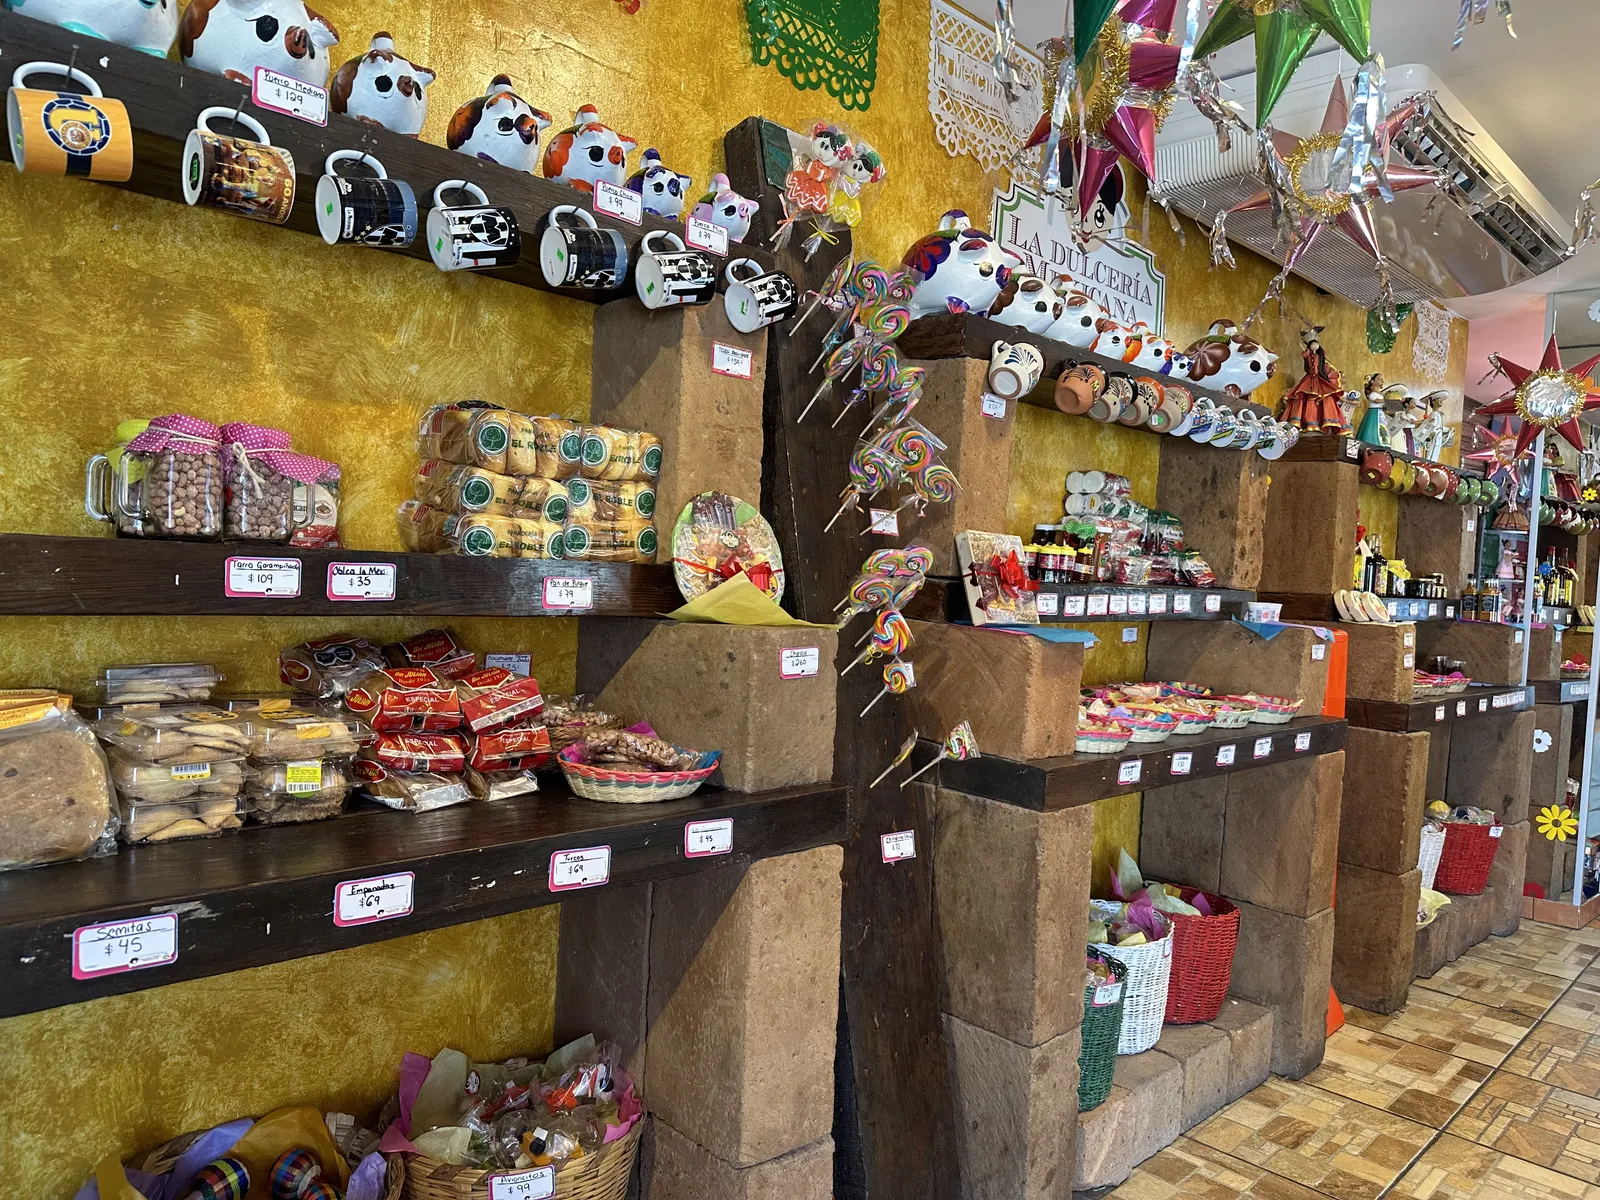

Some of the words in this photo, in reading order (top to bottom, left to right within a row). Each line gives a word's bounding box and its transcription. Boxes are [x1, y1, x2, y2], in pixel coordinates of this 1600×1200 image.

[295, 81, 325, 100] Mediano
[1008, 214, 1043, 257] LA
[1050, 238, 1153, 306] DULCERÍA
[1023, 252, 1137, 324] MICANA
[232, 560, 254, 569] Tarro
[332, 566, 356, 575] Oblea
[563, 853, 584, 861] Turcos
[351, 879, 395, 897] Empanadas
[501, 1171, 545, 1183] Avioncitos
